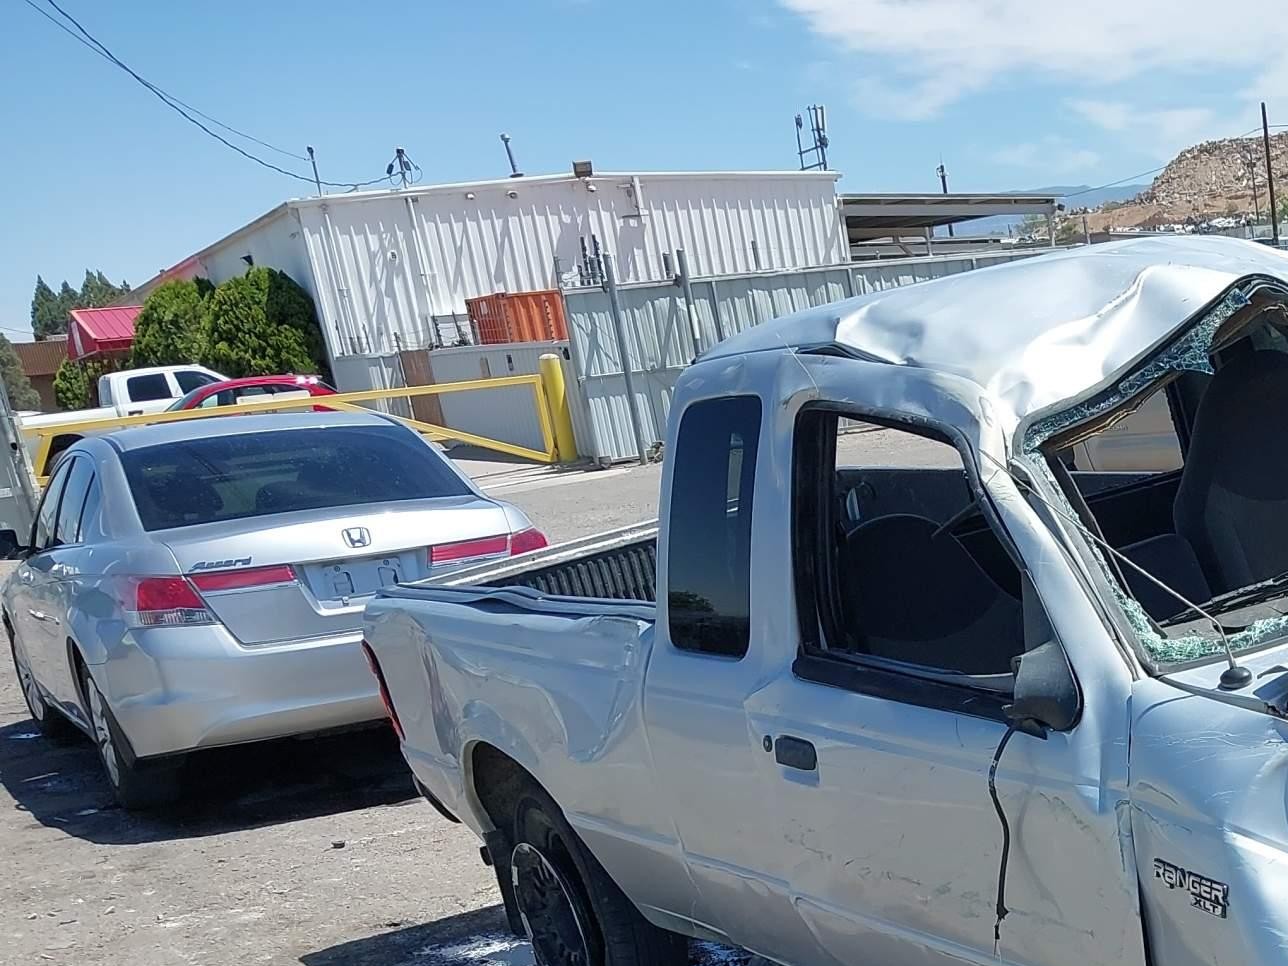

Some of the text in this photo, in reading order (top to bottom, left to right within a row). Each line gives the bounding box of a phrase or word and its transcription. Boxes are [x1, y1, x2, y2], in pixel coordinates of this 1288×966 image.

[188, 556, 253, 572] Accord
[1153, 857, 1229, 907] RANGER
[1192, 897, 1221, 916] XLT
